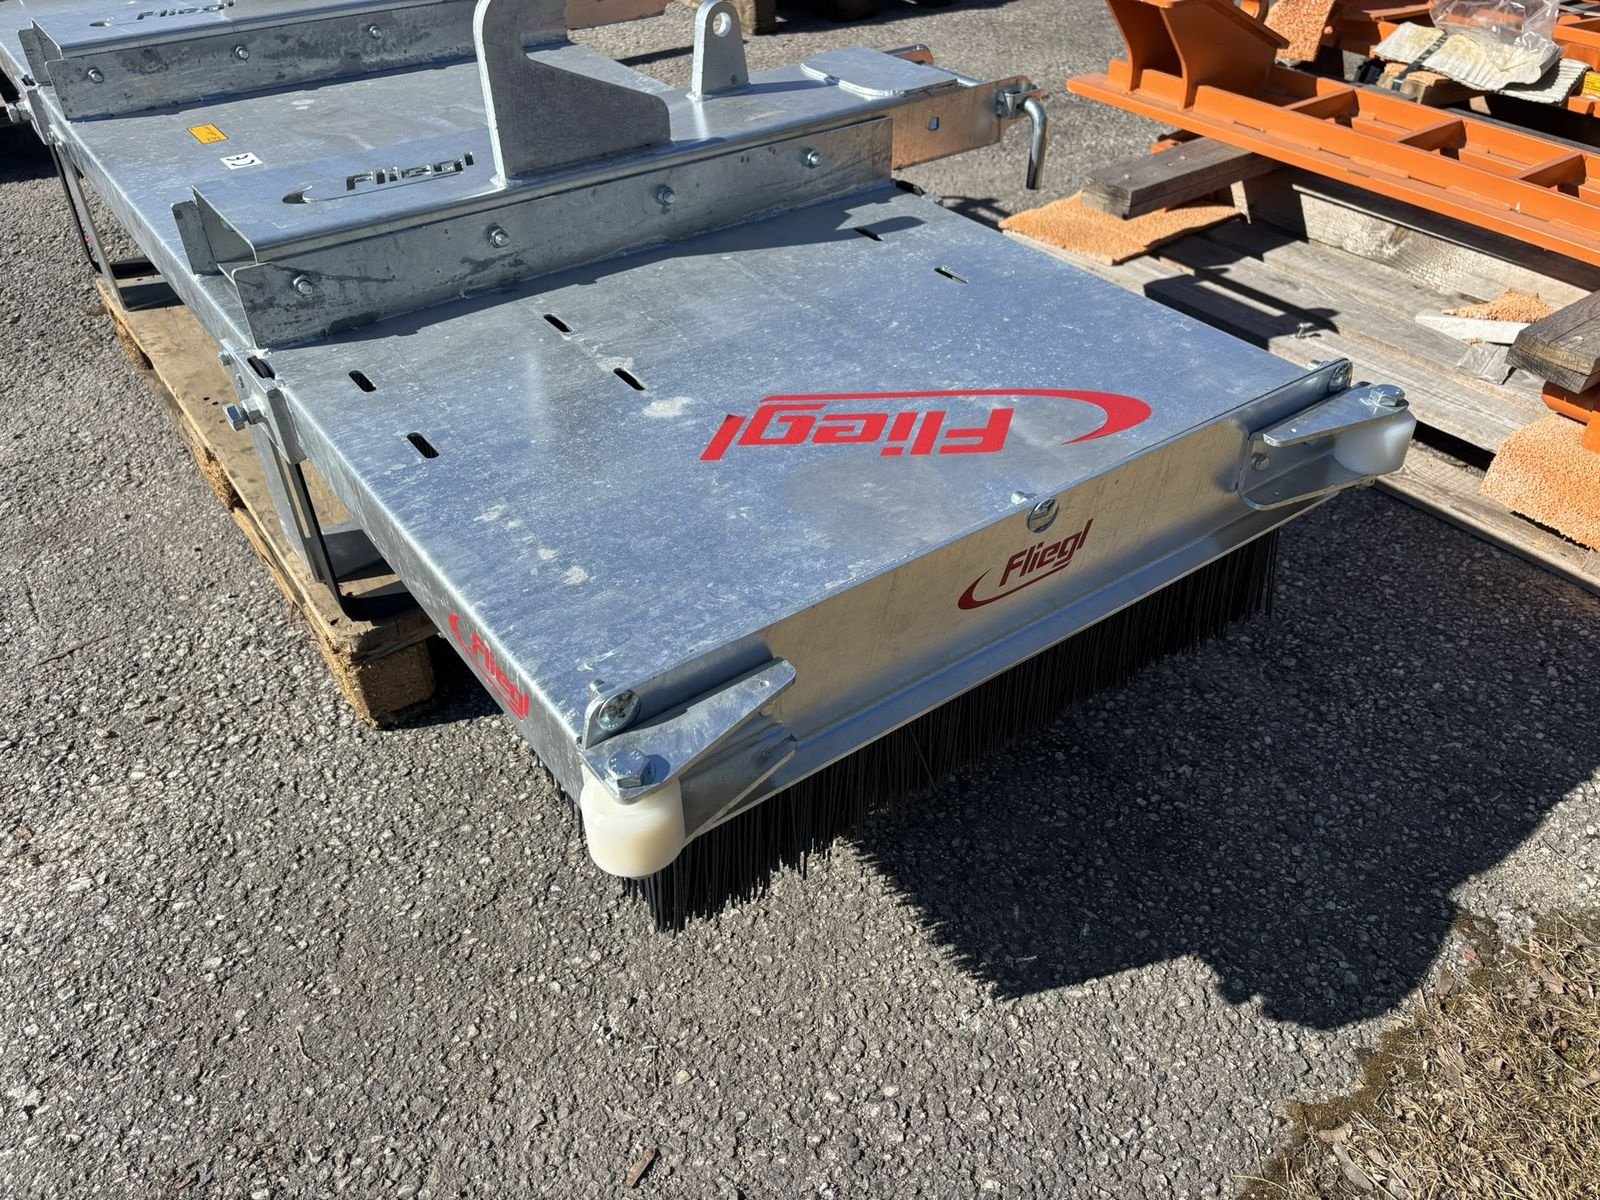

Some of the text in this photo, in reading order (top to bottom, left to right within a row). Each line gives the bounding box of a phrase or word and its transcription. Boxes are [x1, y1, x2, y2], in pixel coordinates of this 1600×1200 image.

[346, 152, 474, 191] Fliegl
[700, 403, 1014, 461] Fliegl
[999, 518, 1094, 587] Fliegl
[471, 632, 529, 719] Fliegl
